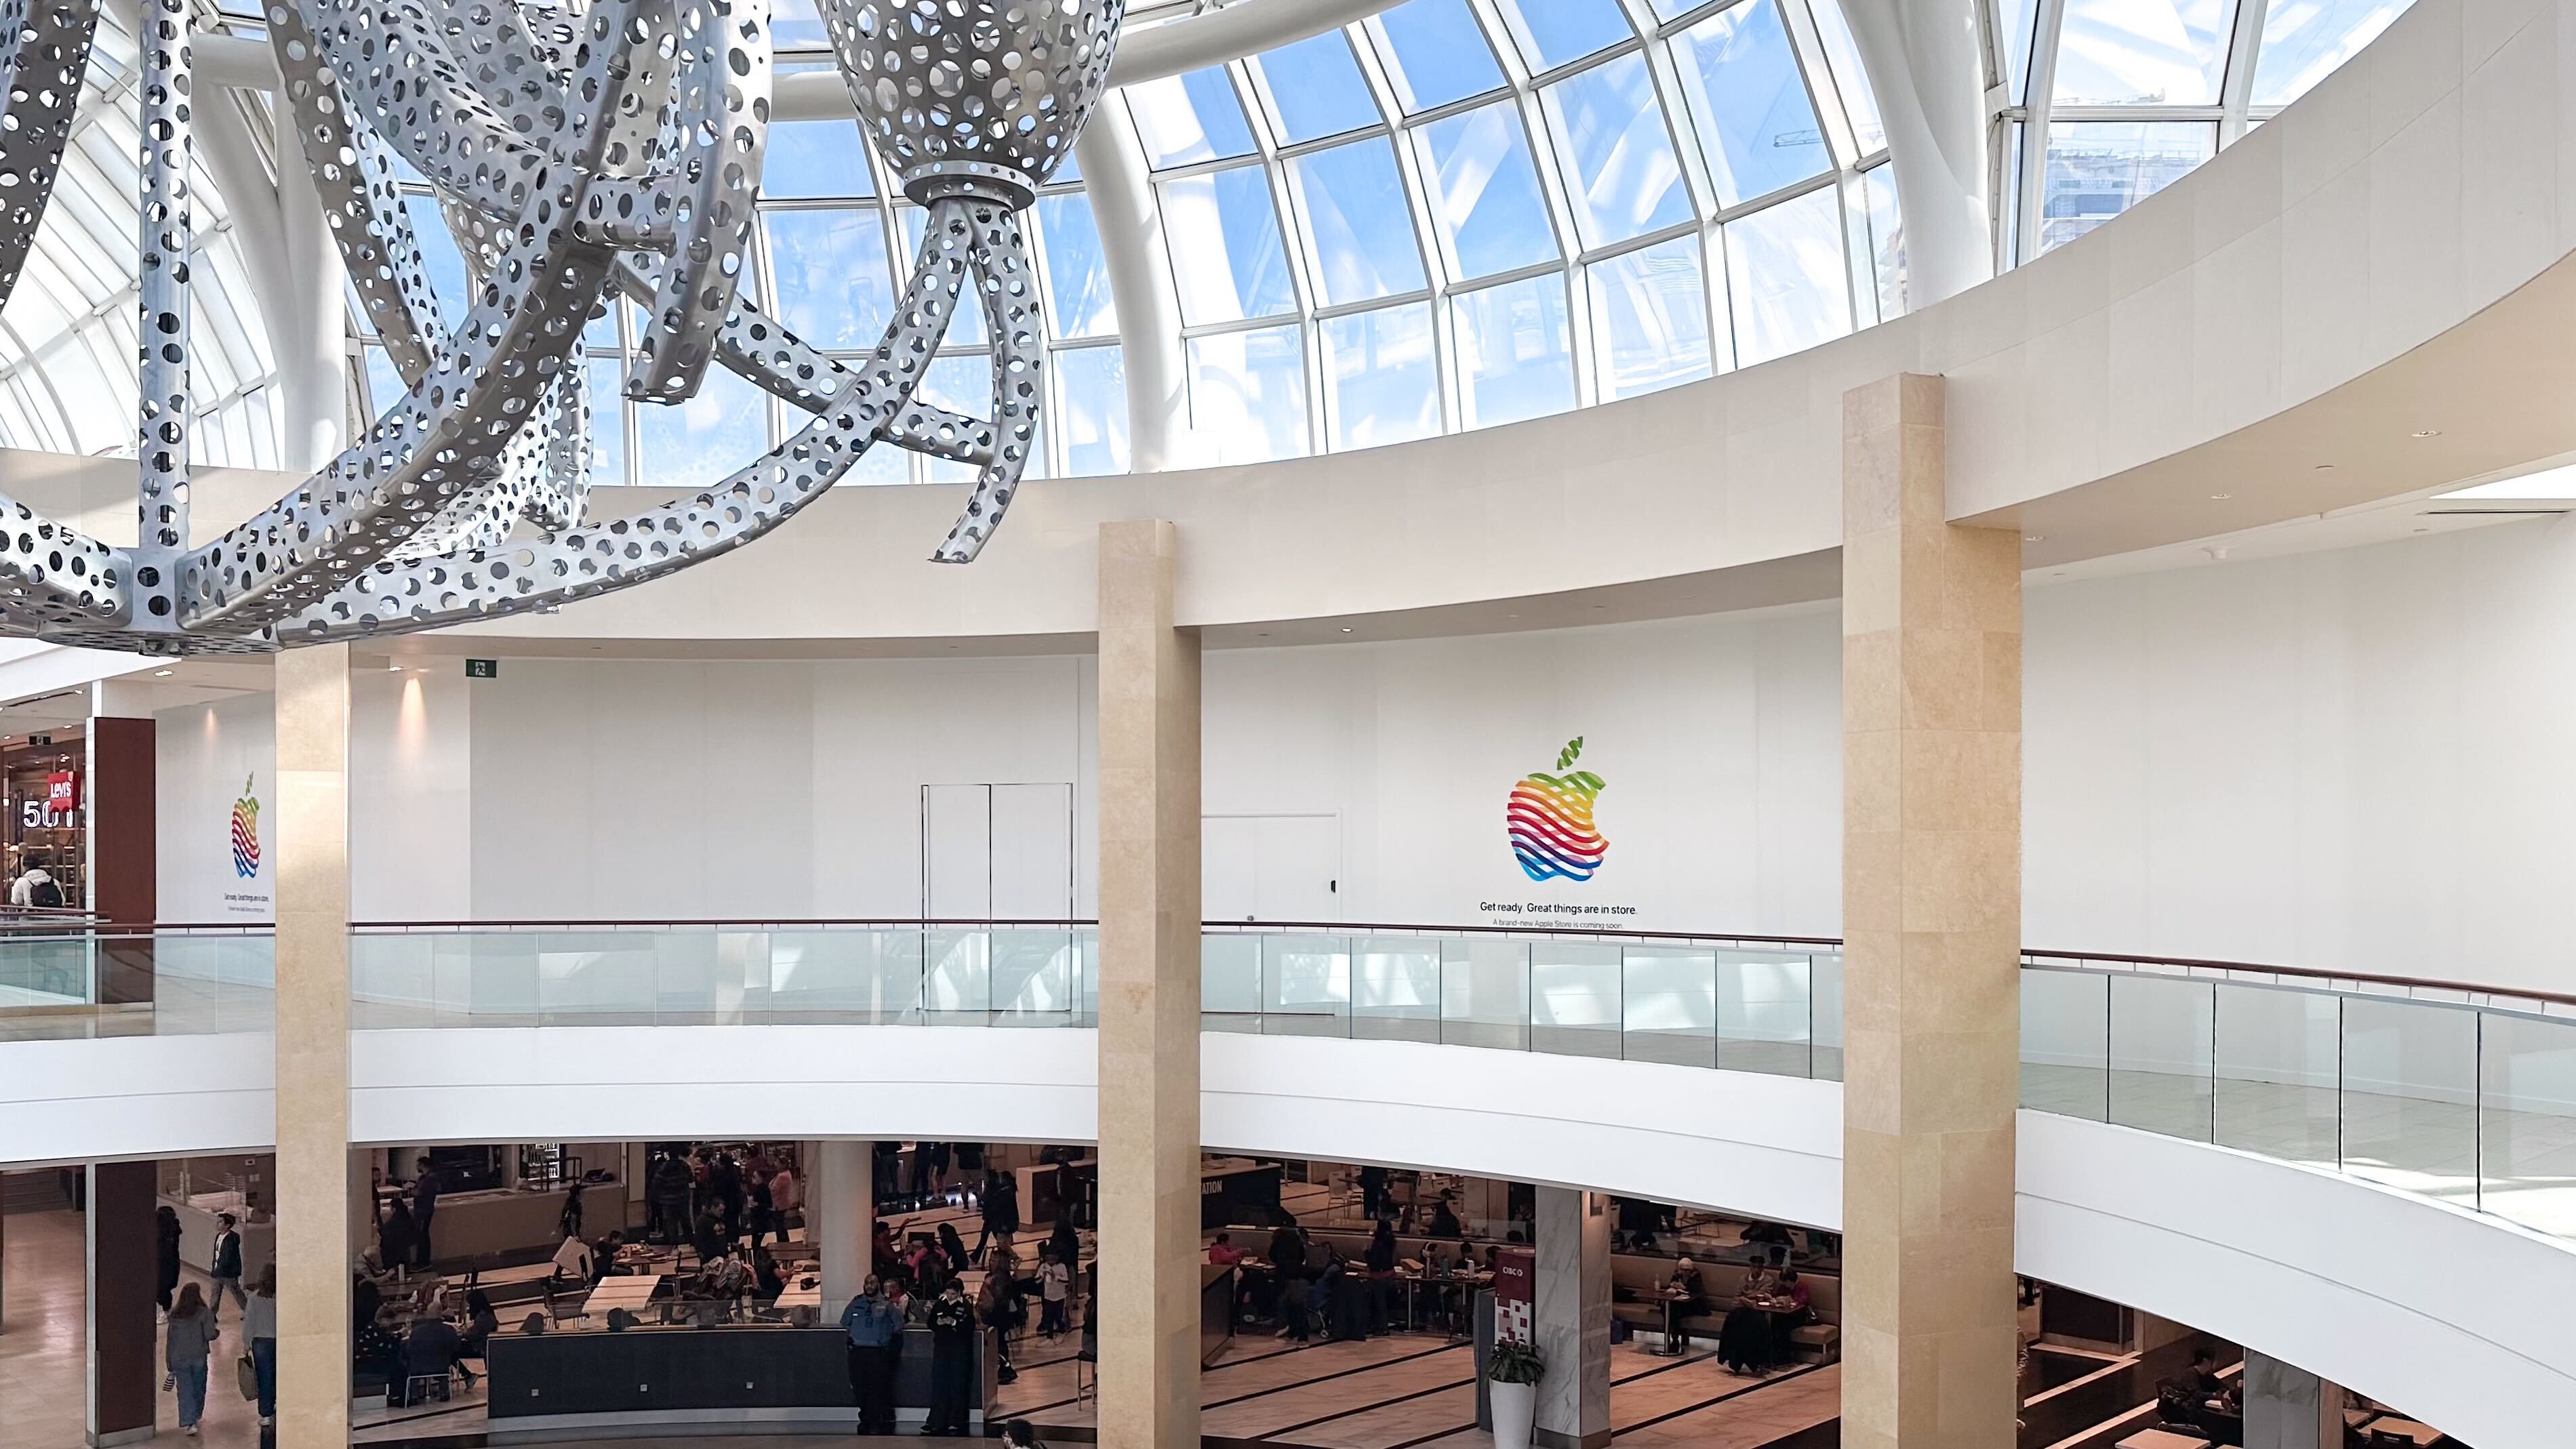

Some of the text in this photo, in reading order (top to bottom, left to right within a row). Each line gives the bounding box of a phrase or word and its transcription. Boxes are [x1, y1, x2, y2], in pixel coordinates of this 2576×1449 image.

[1480, 901, 1495, 911] Get
[1527, 903, 1552, 912] Great
[1554, 903, 1582, 915] things
[1601, 905, 1609, 914] in
[1611, 905, 1637, 915] store.
[1535, 920, 1553, 928] Apple
